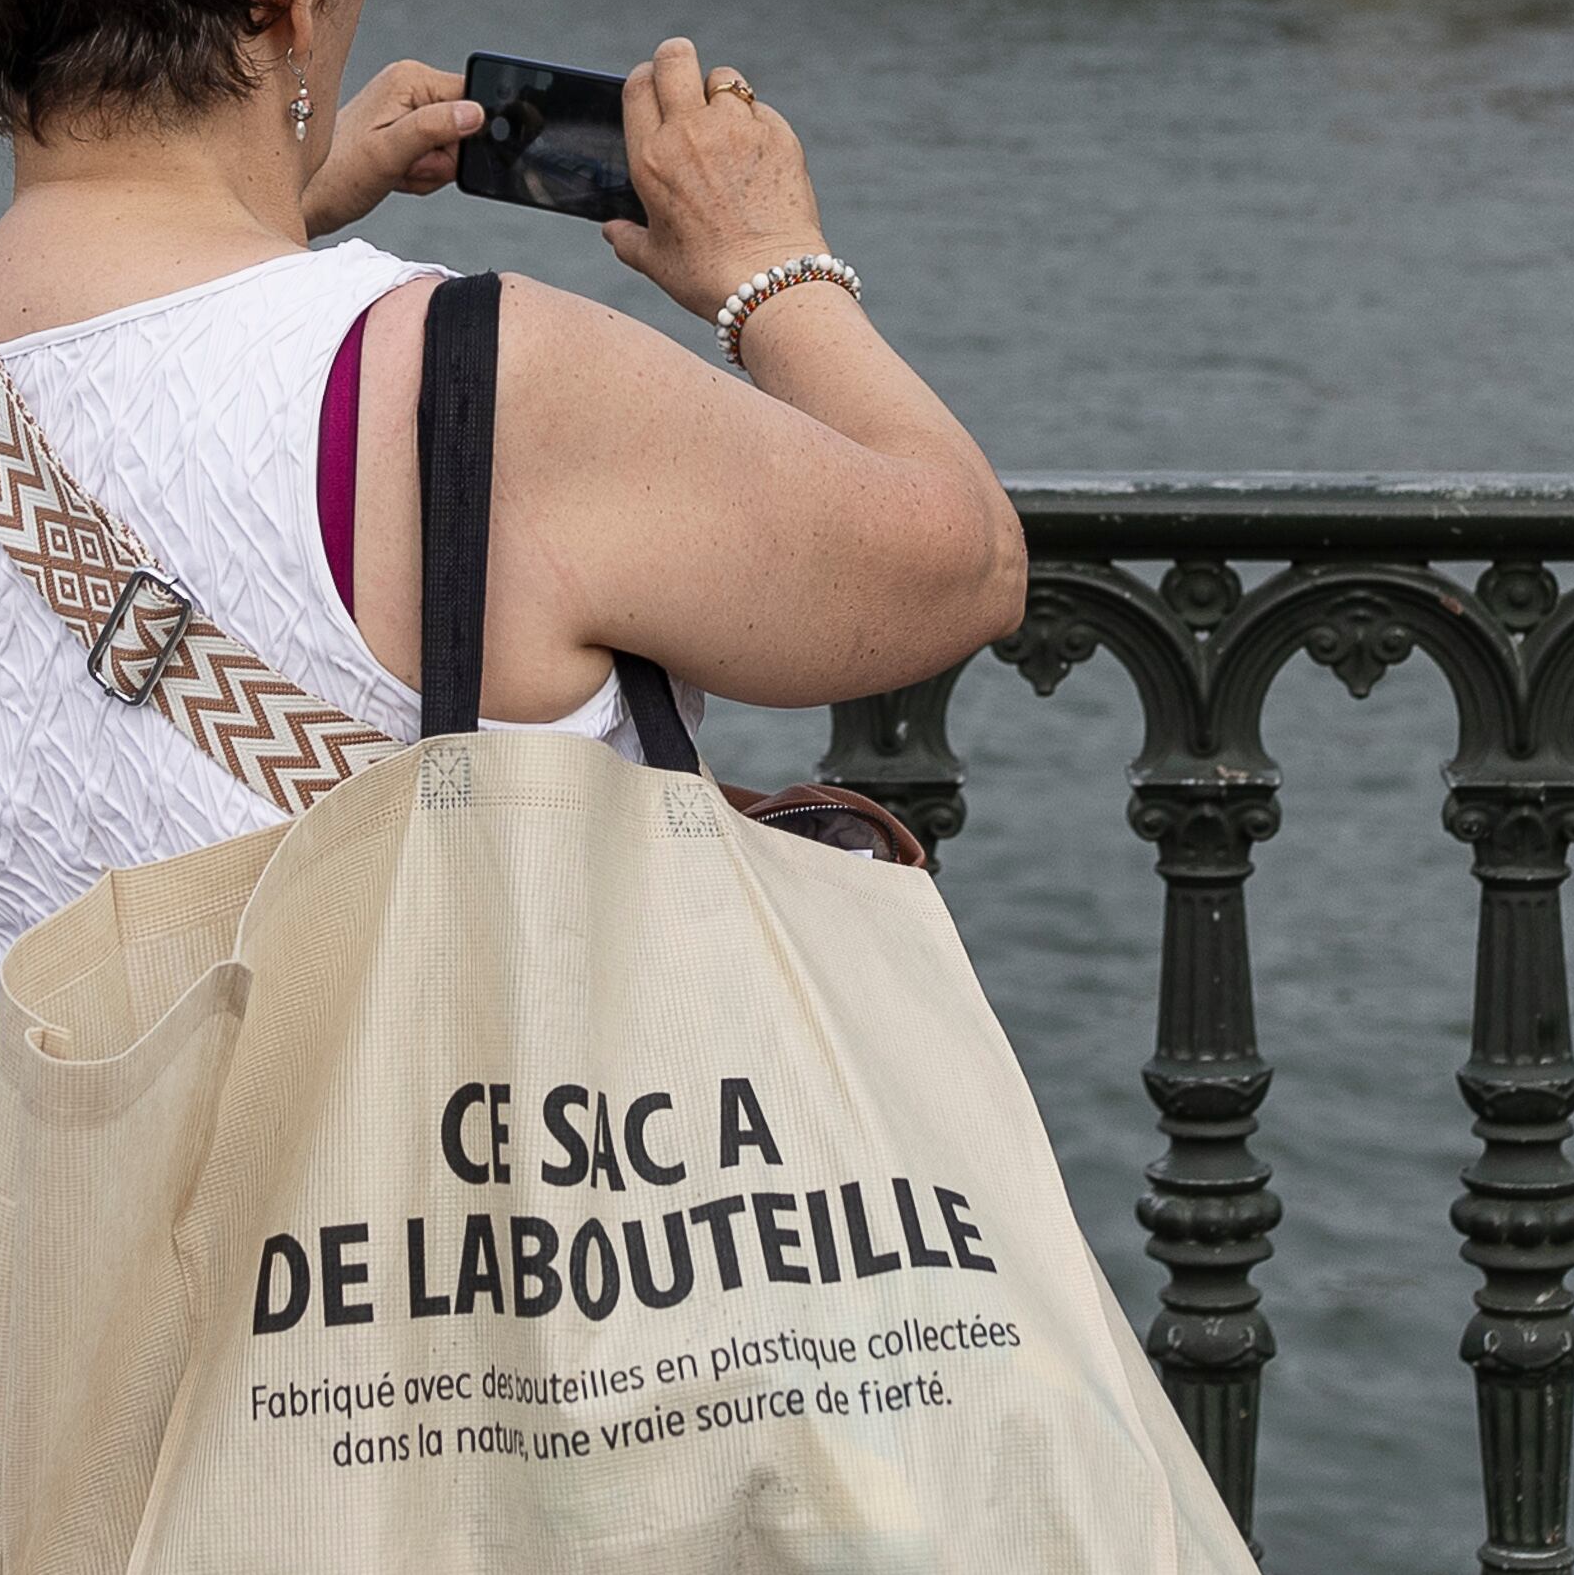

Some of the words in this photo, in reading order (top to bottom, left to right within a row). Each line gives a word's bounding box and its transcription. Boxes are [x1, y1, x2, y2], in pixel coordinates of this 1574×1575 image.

[440, 1081, 511, 1185] CE
[540, 1083, 687, 1192] SAC
[719, 1077, 784, 1168] A
[252, 1222, 374, 1336] DE
[252, 1372, 395, 1420] Fabriqué
[404, 1372, 473, 1403] avec
[482, 1364, 513, 1399] des
[515, 1365, 645, 1405] bouteilles
[656, 1353, 698, 1383] en
[710, 1328, 857, 1381] plastique
[868, 1315, 1021, 1359] collectées
[332, 1431, 409, 1467] dans
[419, 1423, 442, 1456] la
[457, 1421, 529, 1462] nature,
[533, 1429, 591, 1460] une
[600, 1405, 685, 1451] vraie
[697, 1387, 805, 1432] source
[815, 1381, 850, 1416] de
[858, 1370, 953, 1415] fierté.
